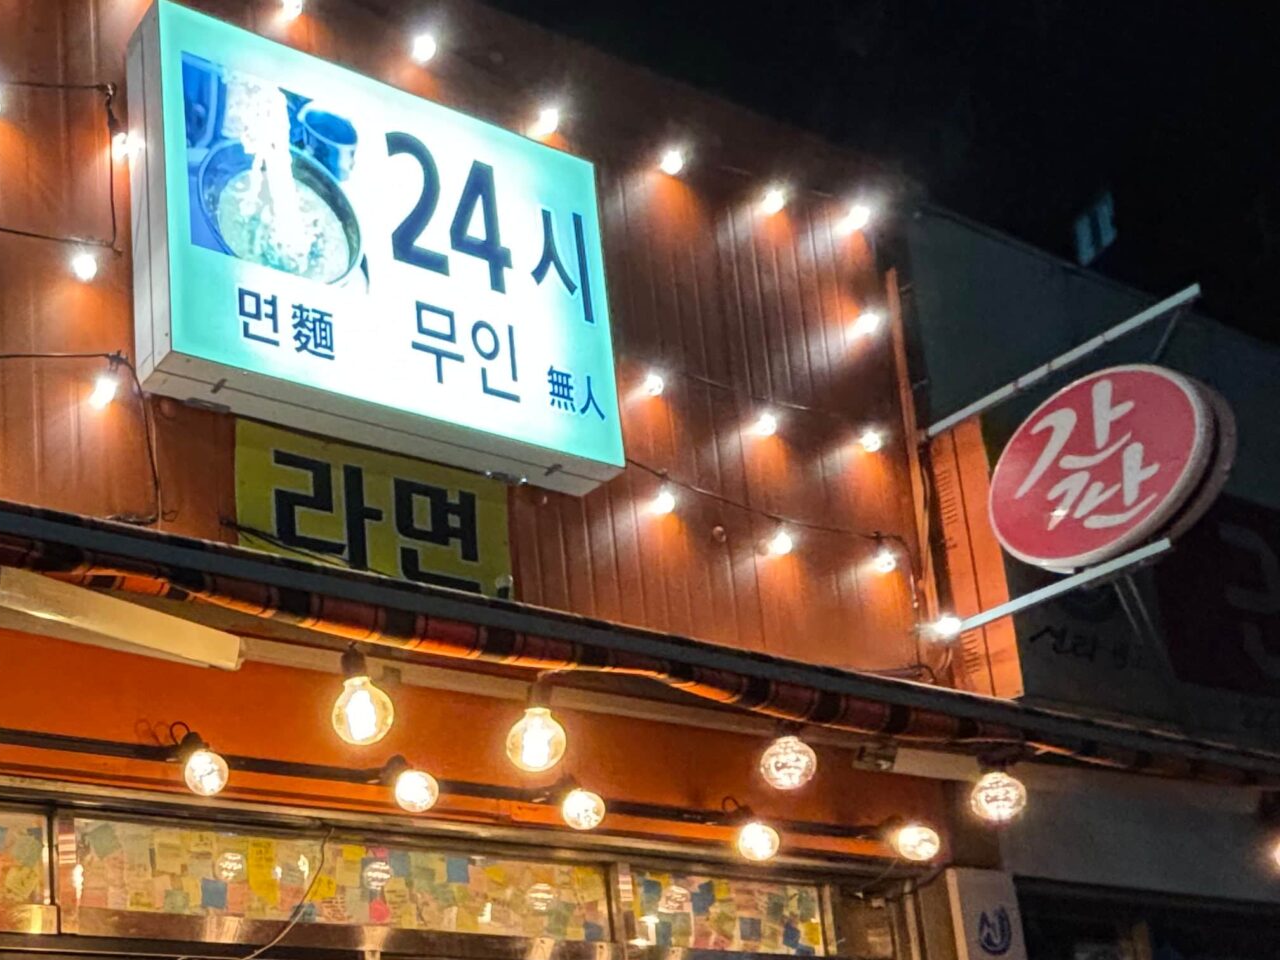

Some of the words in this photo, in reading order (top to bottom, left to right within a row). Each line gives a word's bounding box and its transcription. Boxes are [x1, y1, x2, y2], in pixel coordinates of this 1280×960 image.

[385, 131, 596, 324] 24시
[411, 301, 521, 403] 무인
[547, 366, 606, 421] 無人
[274, 450, 482, 594] 라면
